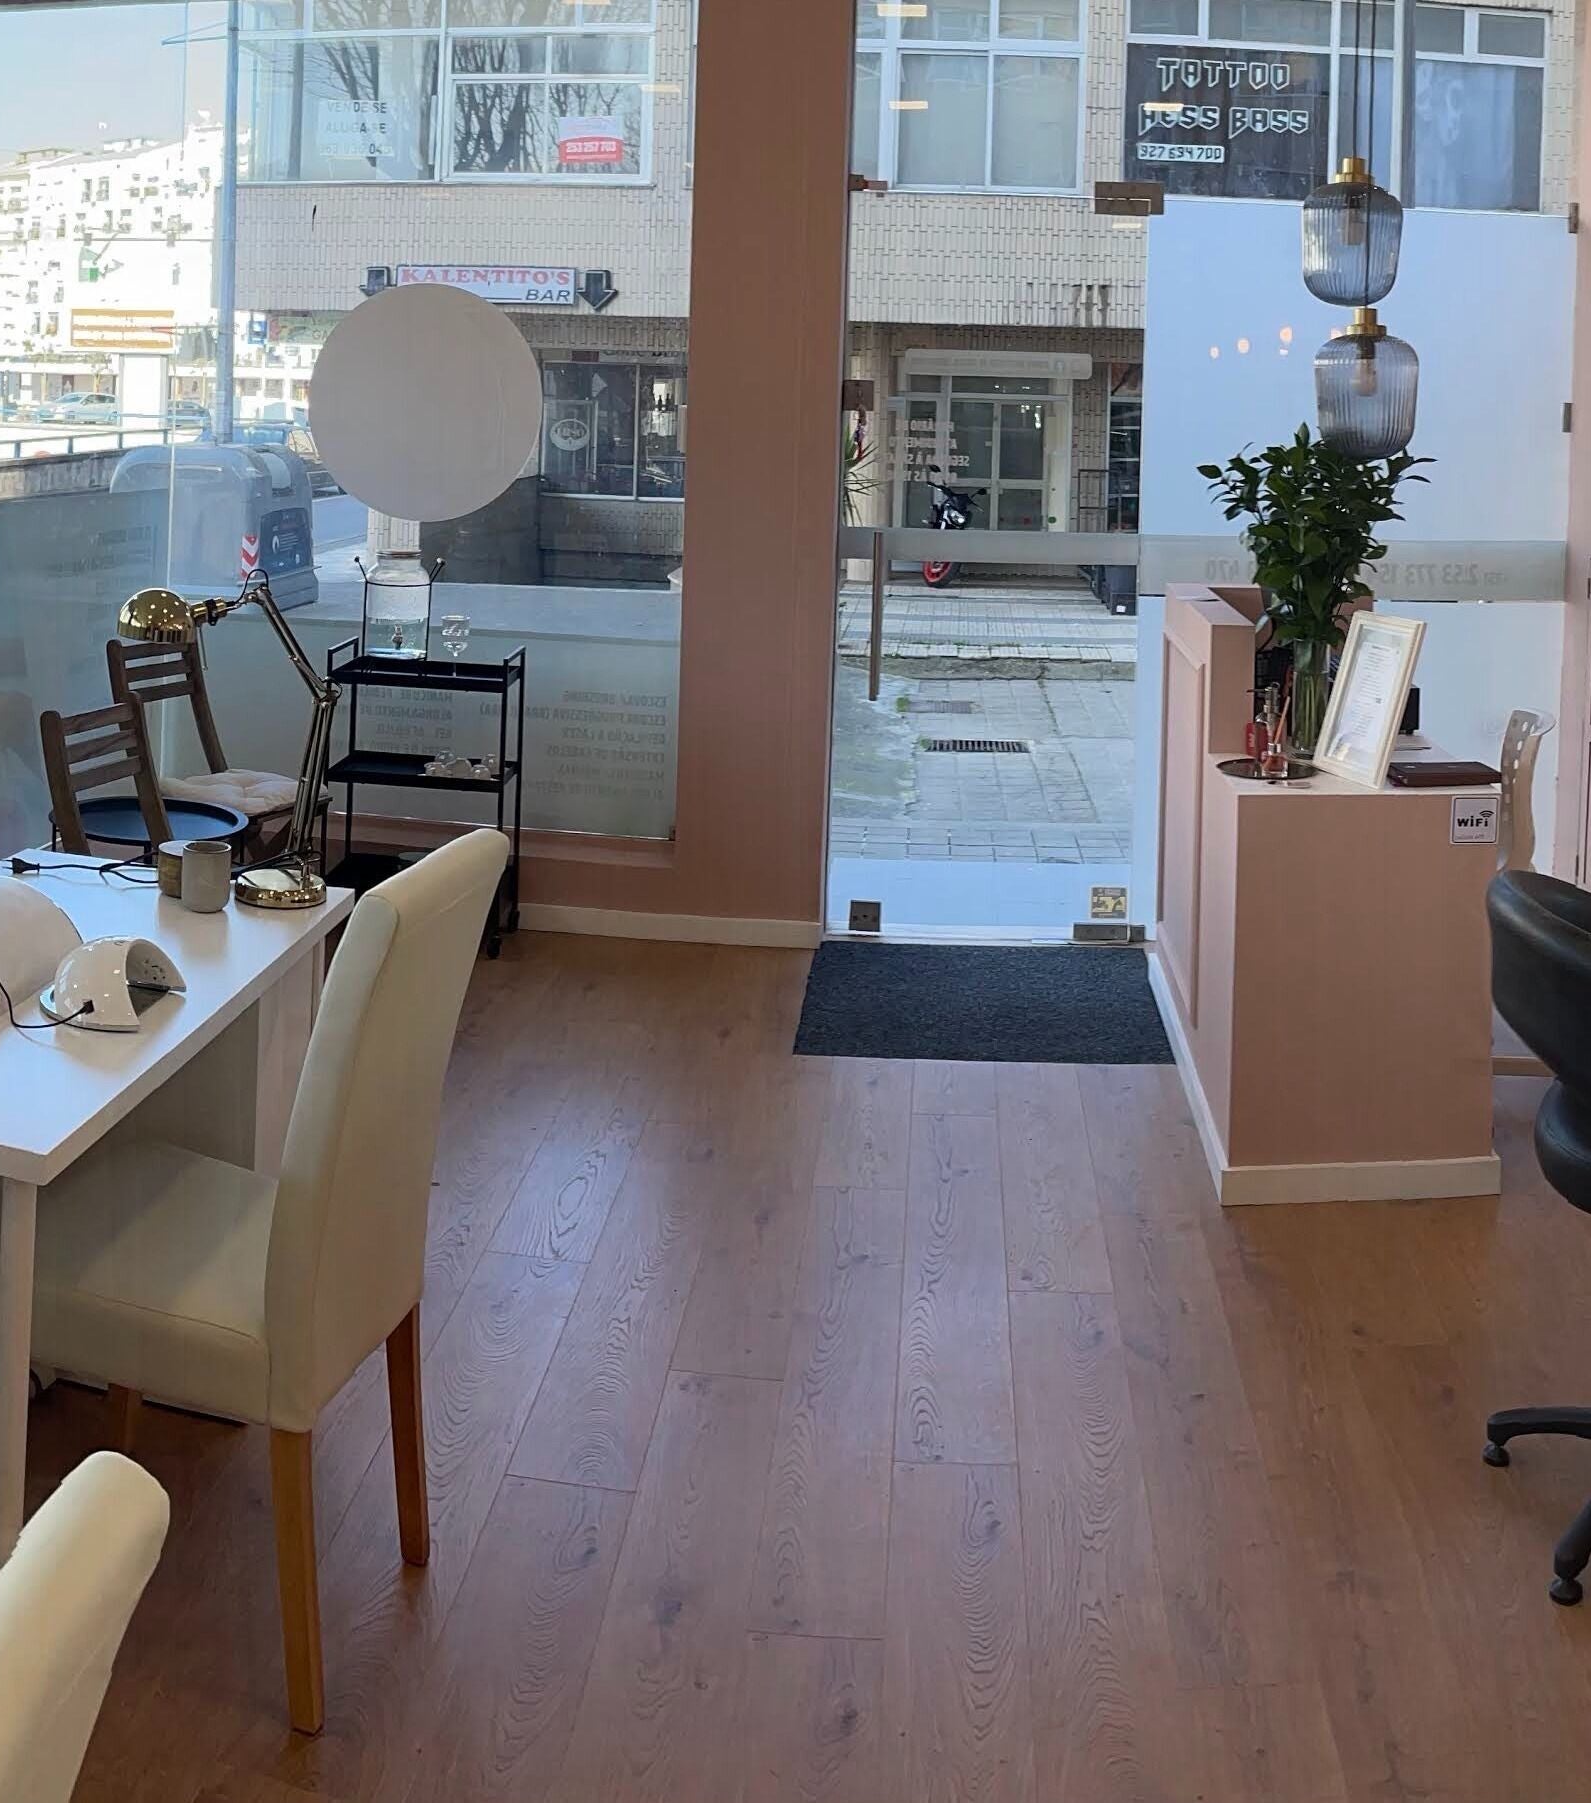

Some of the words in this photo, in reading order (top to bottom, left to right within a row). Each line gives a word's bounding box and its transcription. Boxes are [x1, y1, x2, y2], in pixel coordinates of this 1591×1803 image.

[1156, 57, 1290, 92] TATTOO
[1228, 106, 1309, 139] BASS
[1196, 147, 1222, 160] 700
[401, 268, 570, 285] KALENTITO'S
[525, 289, 570, 302] BAR
